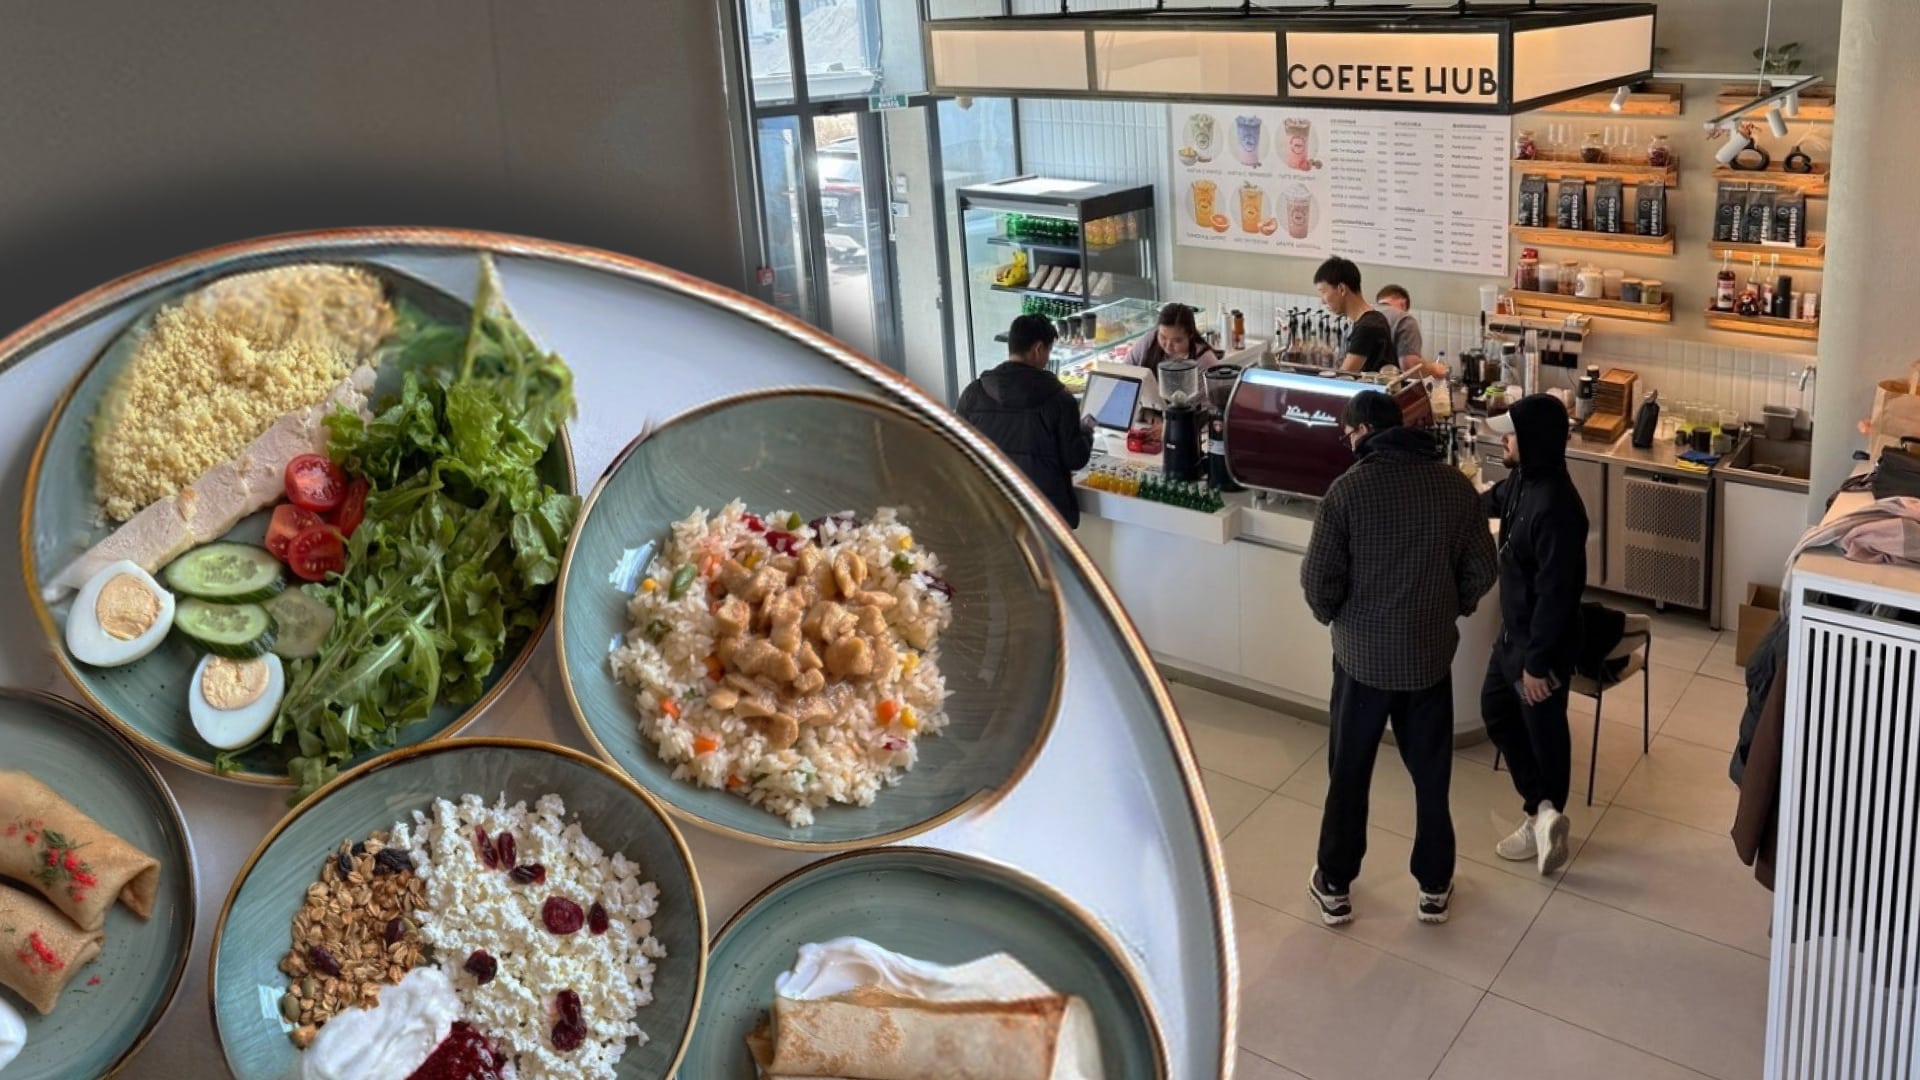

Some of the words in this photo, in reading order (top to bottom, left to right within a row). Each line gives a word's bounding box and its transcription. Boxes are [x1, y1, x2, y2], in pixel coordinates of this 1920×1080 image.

[1288, 63, 1414, 93] COFFEE
[1425, 66, 1498, 95] HUB
[1731, 205, 1741, 241] ESPRESSO
